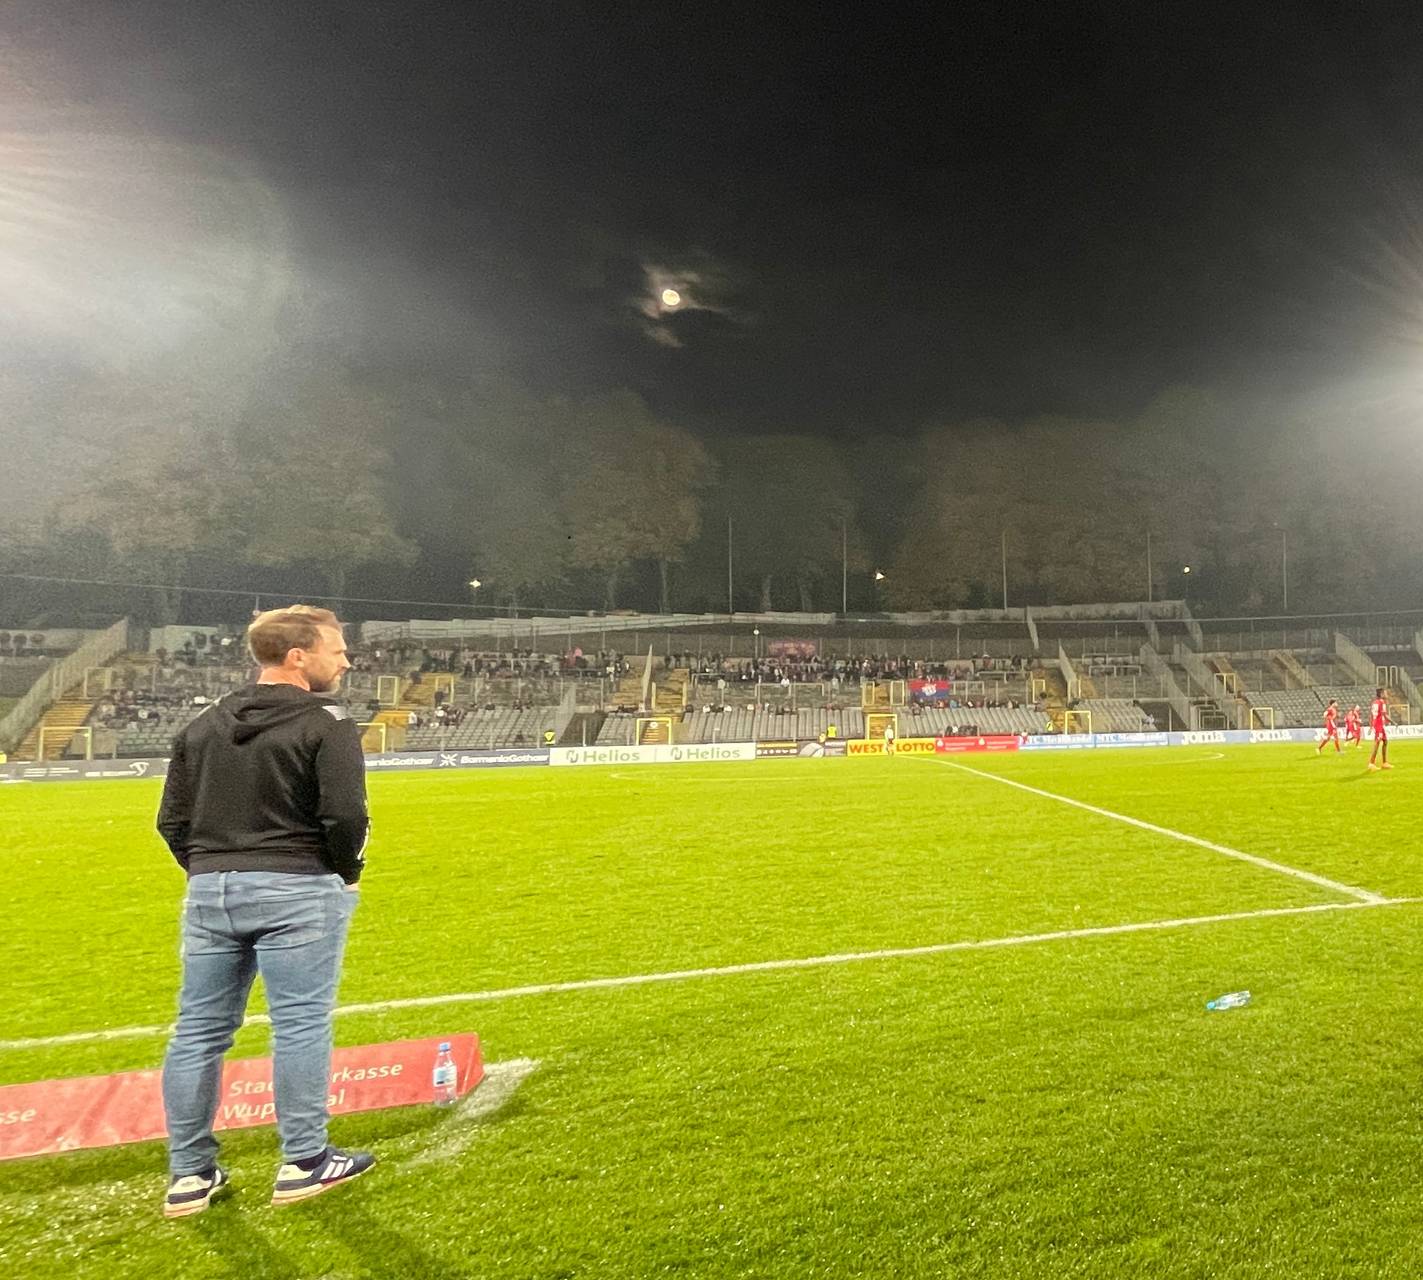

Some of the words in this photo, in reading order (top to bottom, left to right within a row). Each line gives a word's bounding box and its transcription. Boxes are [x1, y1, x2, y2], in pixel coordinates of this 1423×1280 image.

[687, 747, 741, 760] Helios
[849, 744, 884, 754] WEST
[896, 742, 935, 752] LOTTO
[583, 749, 641, 763] Helios
[228, 1063, 403, 1097] Starkasse
[223, 1091, 345, 1120] Wupal
